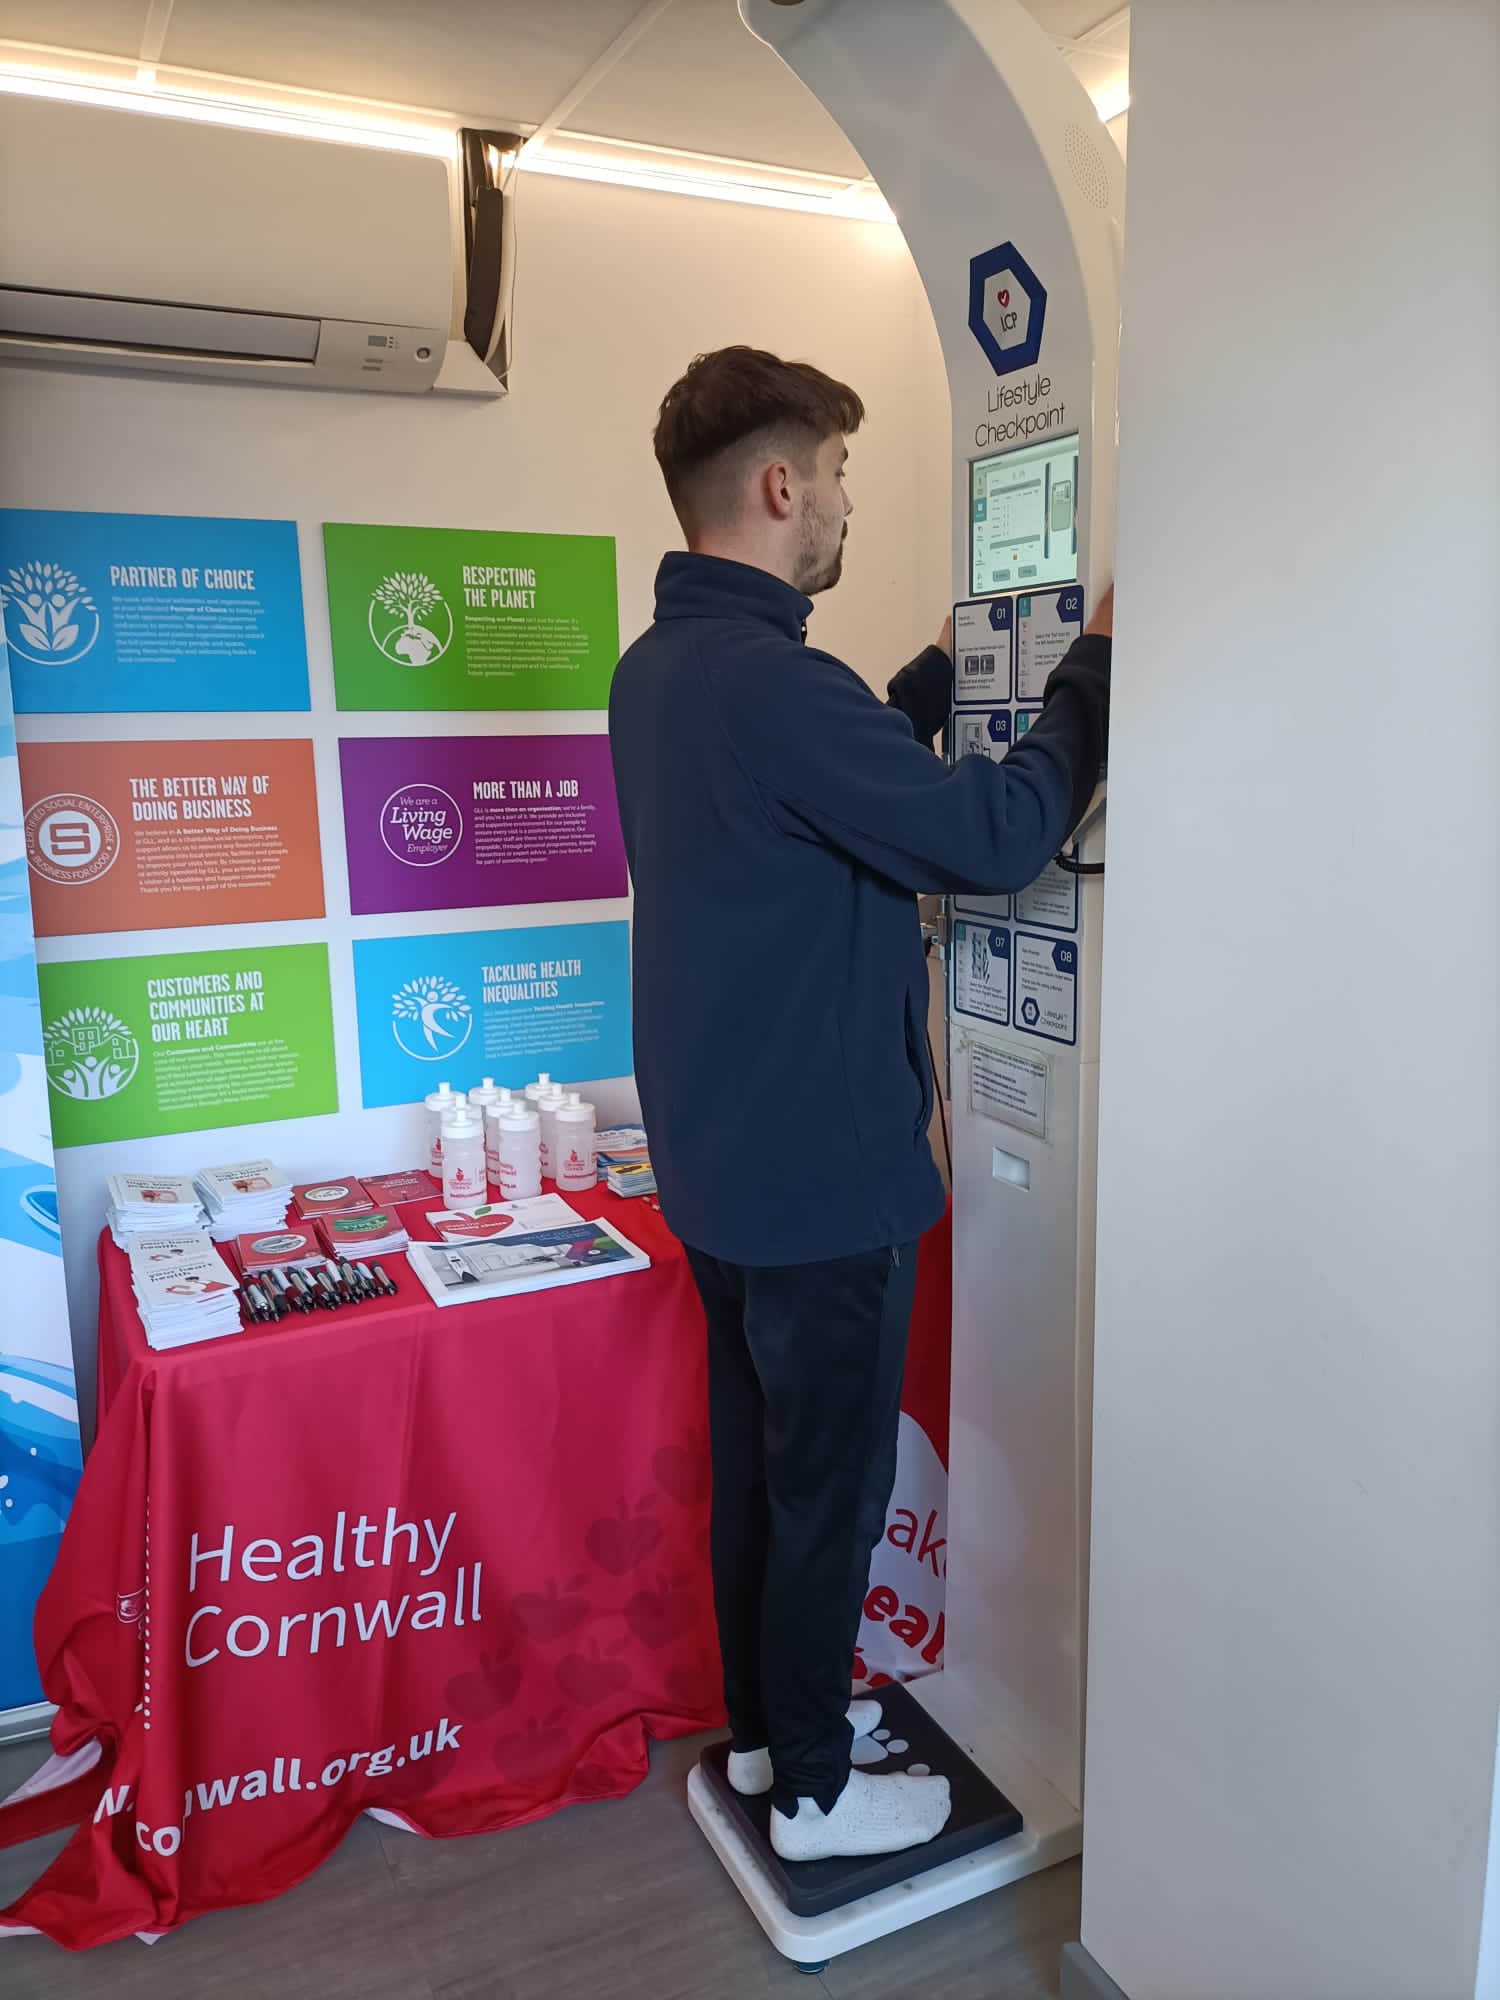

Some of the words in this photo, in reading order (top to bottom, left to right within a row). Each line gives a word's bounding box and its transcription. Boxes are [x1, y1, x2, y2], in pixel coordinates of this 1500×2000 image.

[1000, 312, 1017, 332] LCP
[988, 373, 1051, 413] Lifestyle
[976, 402, 1065, 447] Checkpoint
[110, 565, 177, 588] PARTNER
[182, 568, 199, 588] OF
[205, 569, 255, 590] CHOICE
[462, 566, 536, 586] RESPECTING
[464, 588, 486, 607] THE
[492, 590, 536, 608] PLANET
[1065, 598, 1078, 610] 02
[996, 608, 1006, 619] 01
[995, 720, 1006, 731] 03
[130, 778, 157, 797] THE
[163, 777, 216, 797] BETTER
[221, 776, 247, 795] WAY
[253, 776, 269, 794] OF
[473, 782, 505, 800] MORE
[510, 781, 540, 798] THAN
[545, 781, 552, 798] A
[557, 780, 578, 798] JOB
[133, 801, 177, 821] DOING
[183, 799, 251, 819] BUSINESS
[400, 796, 414, 805] We
[43, 799, 77, 810] SOCIAL
[79, 801, 113, 843] ENTERPRISE
[390, 807, 446, 826] Living
[402, 824, 453, 844] Wage
[408, 843, 448, 854] Employer
[73, 869, 89, 879] FOR
[90, 853, 109, 872] GOOD
[995, 936, 1005, 947] 07
[1060, 951, 1072, 963] 08
[481, 964, 536, 983] TACKLING
[541, 960, 581, 977] HEALTH
[148, 974, 229, 998] CUSTOMERS
[235, 971, 263, 990] AND
[482, 981, 558, 1004] INEQUALITIES
[150, 995, 245, 1020] COMMUNITIES
[250, 992, 264, 1011] AT
[152, 1023, 180, 1042] OUR
[186, 1018, 228, 1039] HEART
[189, 1507, 457, 1592] Healthy
[886, 1508, 947, 1578] ak
[185, 1561, 482, 1667] Cornwall
